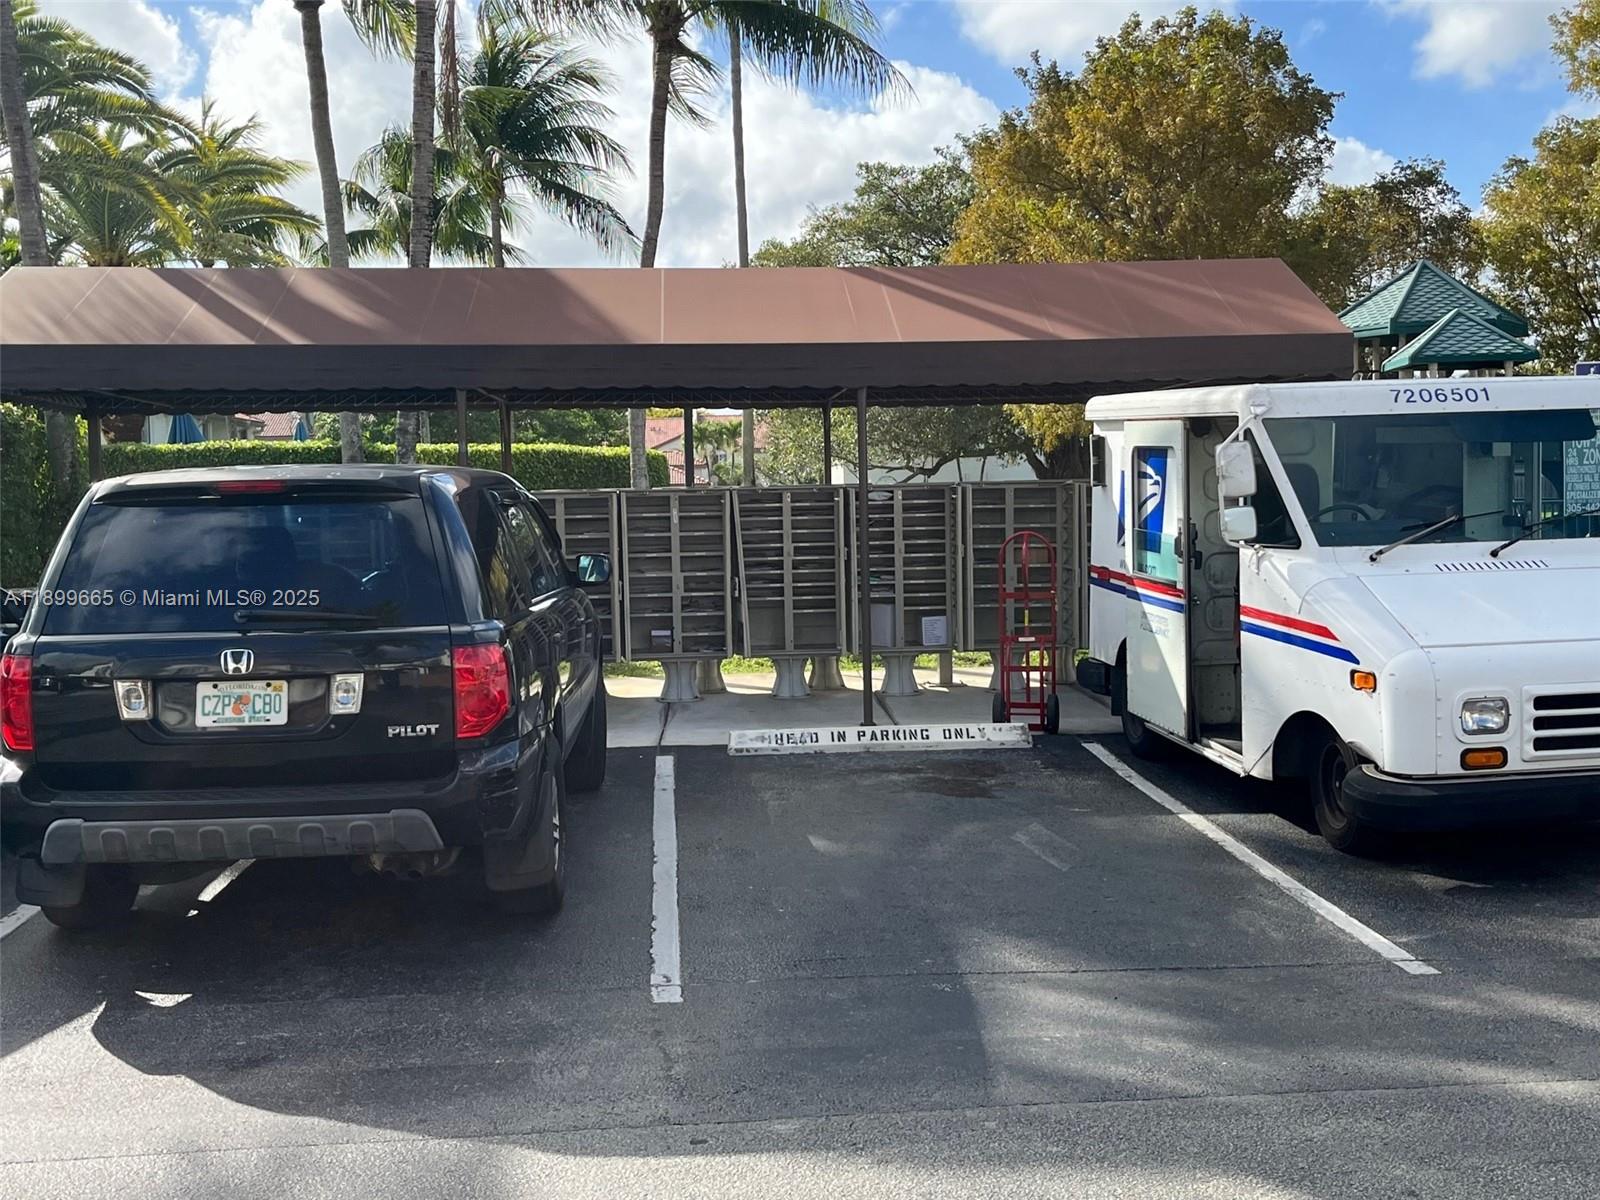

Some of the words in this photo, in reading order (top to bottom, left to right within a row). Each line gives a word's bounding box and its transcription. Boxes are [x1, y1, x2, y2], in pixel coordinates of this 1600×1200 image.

[1389, 387, 1490, 403] 7206501
[201, 695, 232, 716] CZP
[387, 724, 440, 737] PILOT
[831, 730, 847, 742] IN
[857, 728, 930, 742] PARKING
